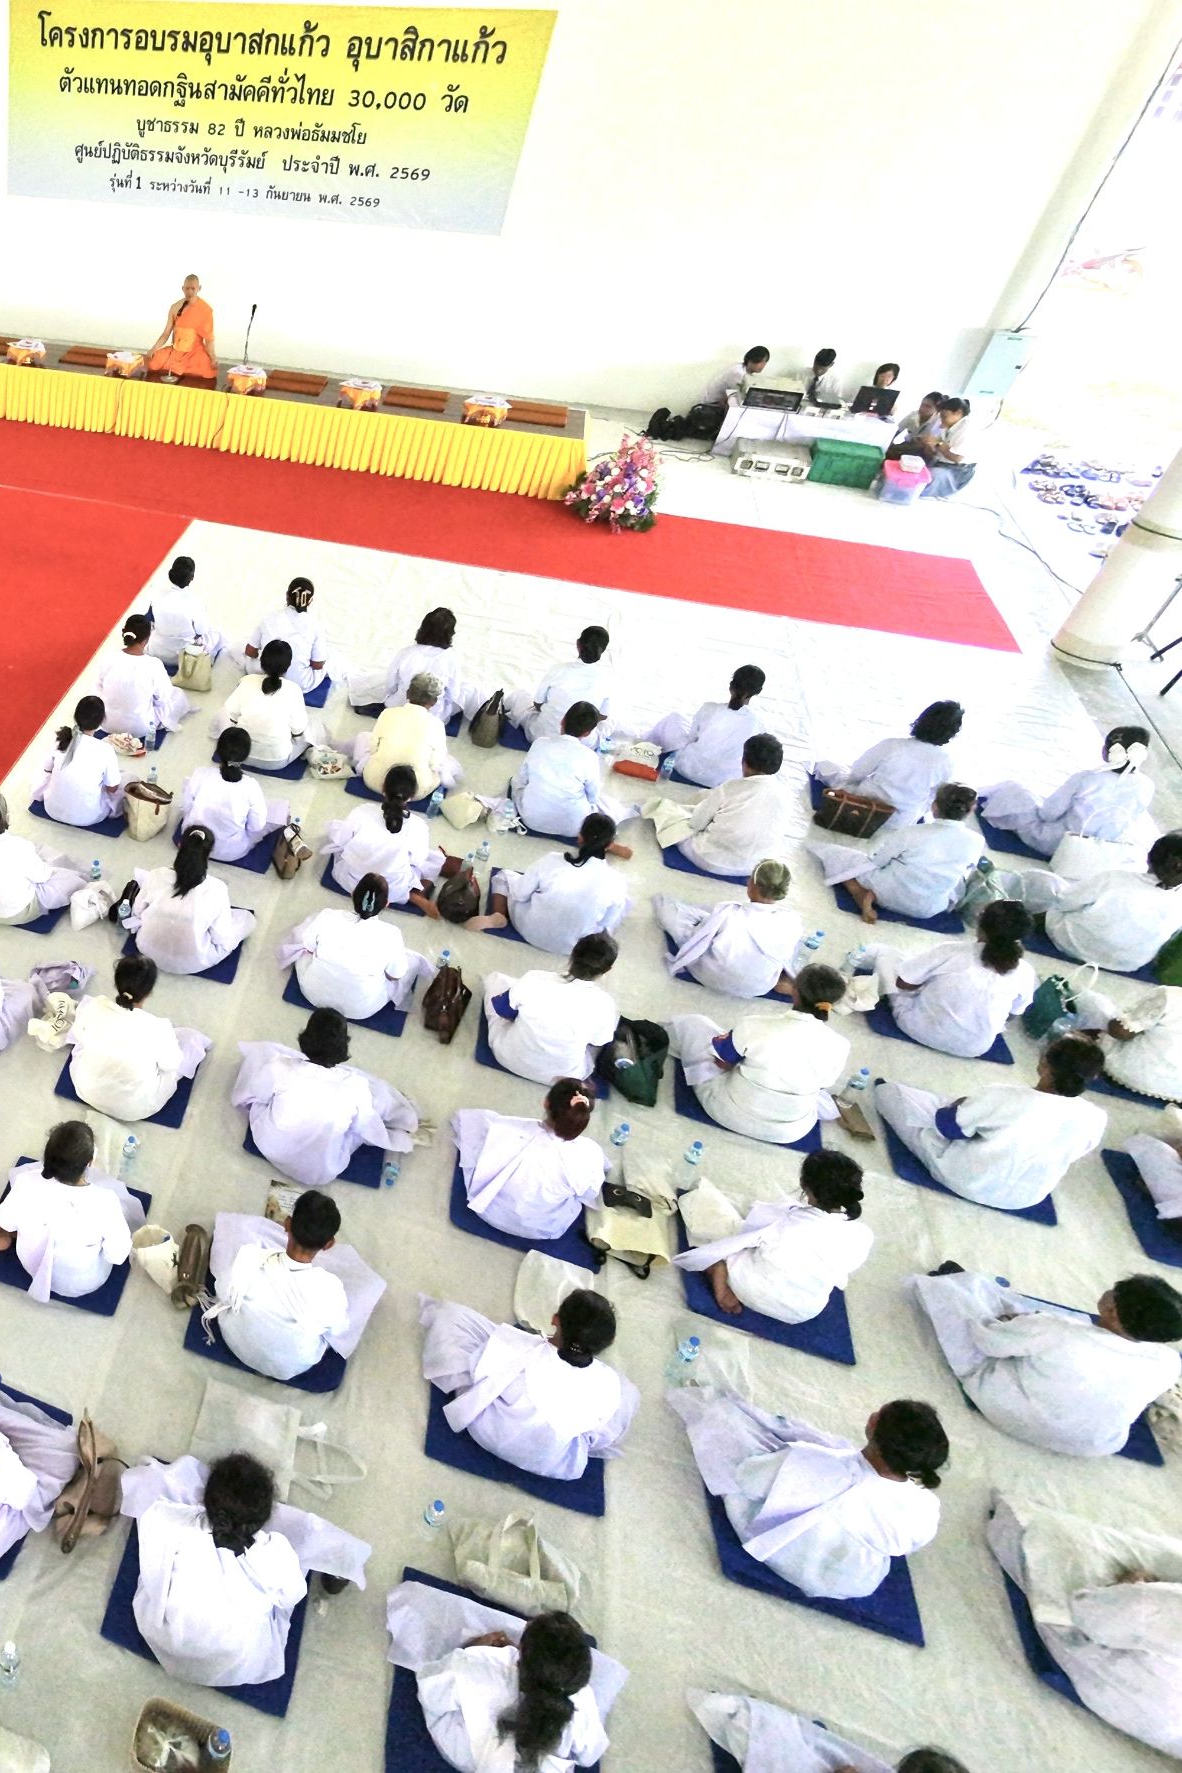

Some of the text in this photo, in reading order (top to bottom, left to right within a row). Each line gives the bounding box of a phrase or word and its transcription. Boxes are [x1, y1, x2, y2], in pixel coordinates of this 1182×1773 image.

[37, 9, 508, 73] โครงการอบรมอุบาสกแก้ว อุบาสิกาแก้ว
[59, 66, 470, 114] ตัวแทนทอดกฐินสามัคคีทั่วไทย 30,000 วัด
[136, 117, 368, 145] บูชาธรรม 82 ปี หลวงพ่อธัมมชโย
[74, 140, 431, 182] ศูนย์ปฏิบัติธรรมจังหวัดบุรีรัมย์ ประจำปี พ.ศ. 2569
[109, 169, 133, 193] รุ่นที่
[135, 175, 142, 190] 1
[149, 175, 213, 195] ระหว่างวันที่
[219, 186, 230, 196] 11
[265, 184, 312, 203] กันยายน
[318, 193, 343, 206] พ.ศ.
[349, 195, 381, 208] 2569
